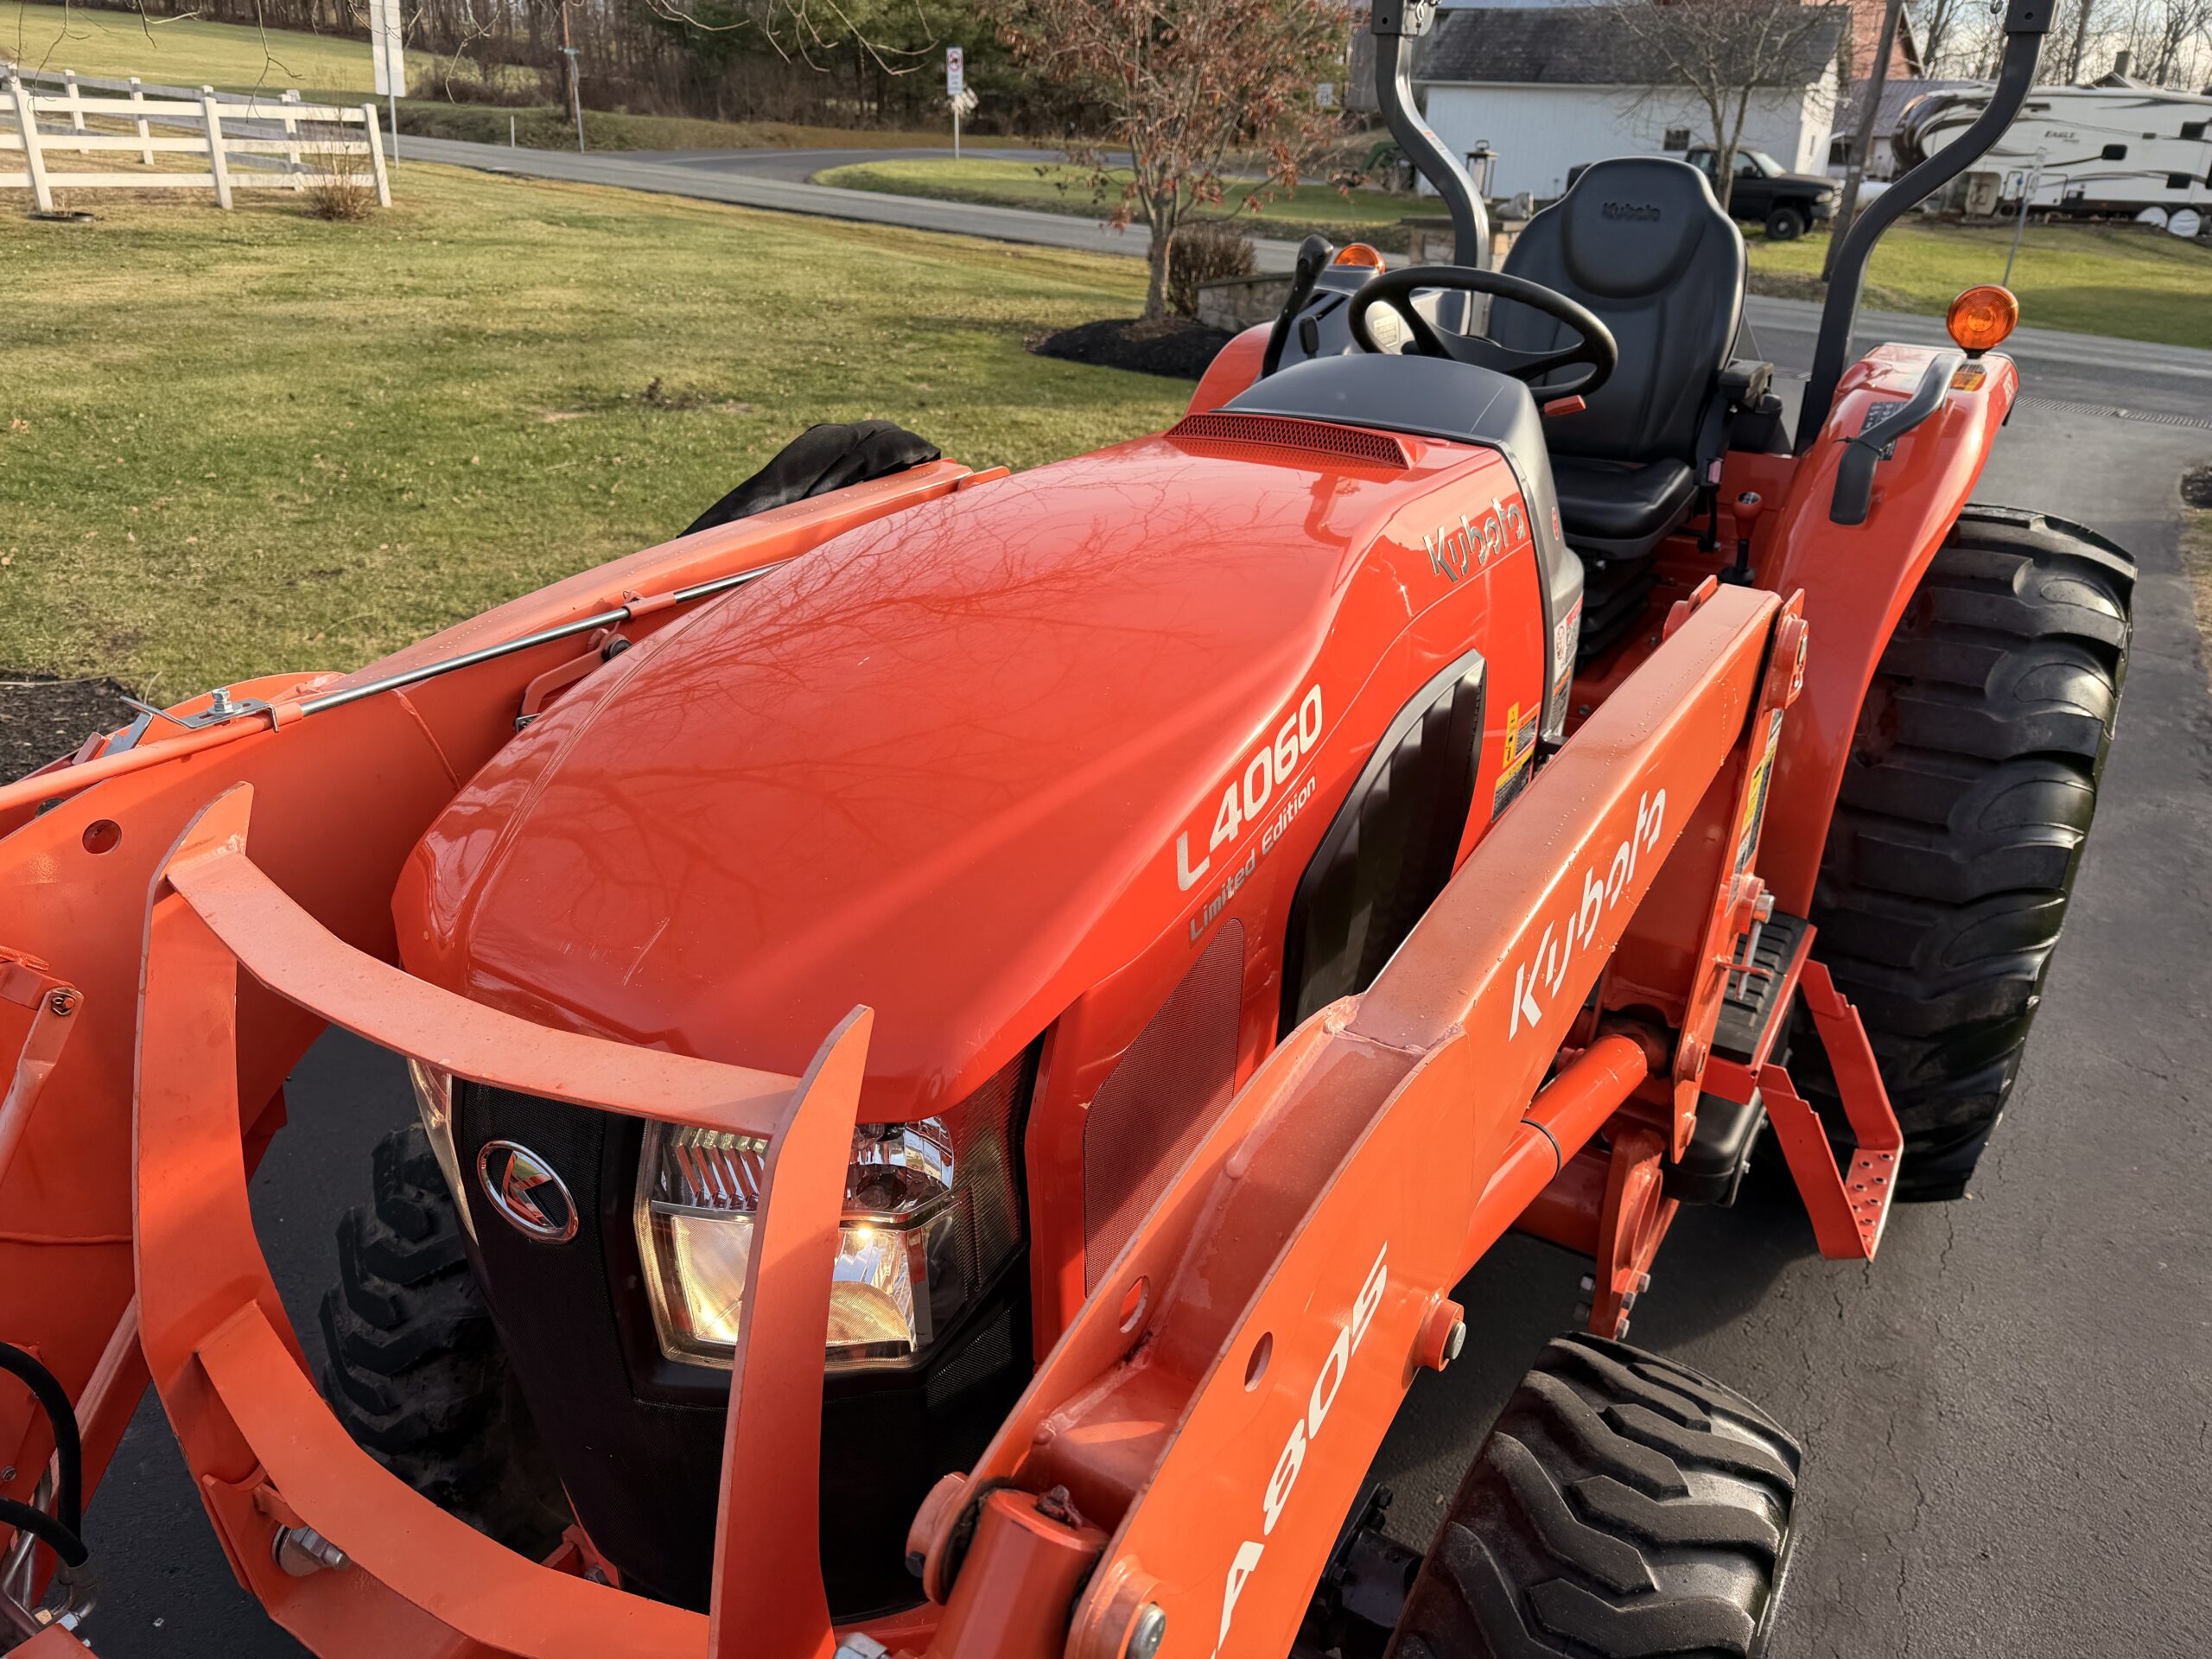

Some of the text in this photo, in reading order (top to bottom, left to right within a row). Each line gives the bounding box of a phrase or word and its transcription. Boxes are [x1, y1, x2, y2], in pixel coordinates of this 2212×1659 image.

[1602, 201, 1661, 222] Kubota
[1422, 497, 1526, 583] Kubota
[1176, 683, 1323, 892] L4060
[1190, 775, 1317, 942] Limited Edition
[1509, 787, 1667, 1043] Kubota
[1210, 1239, 1389, 1659] A805
